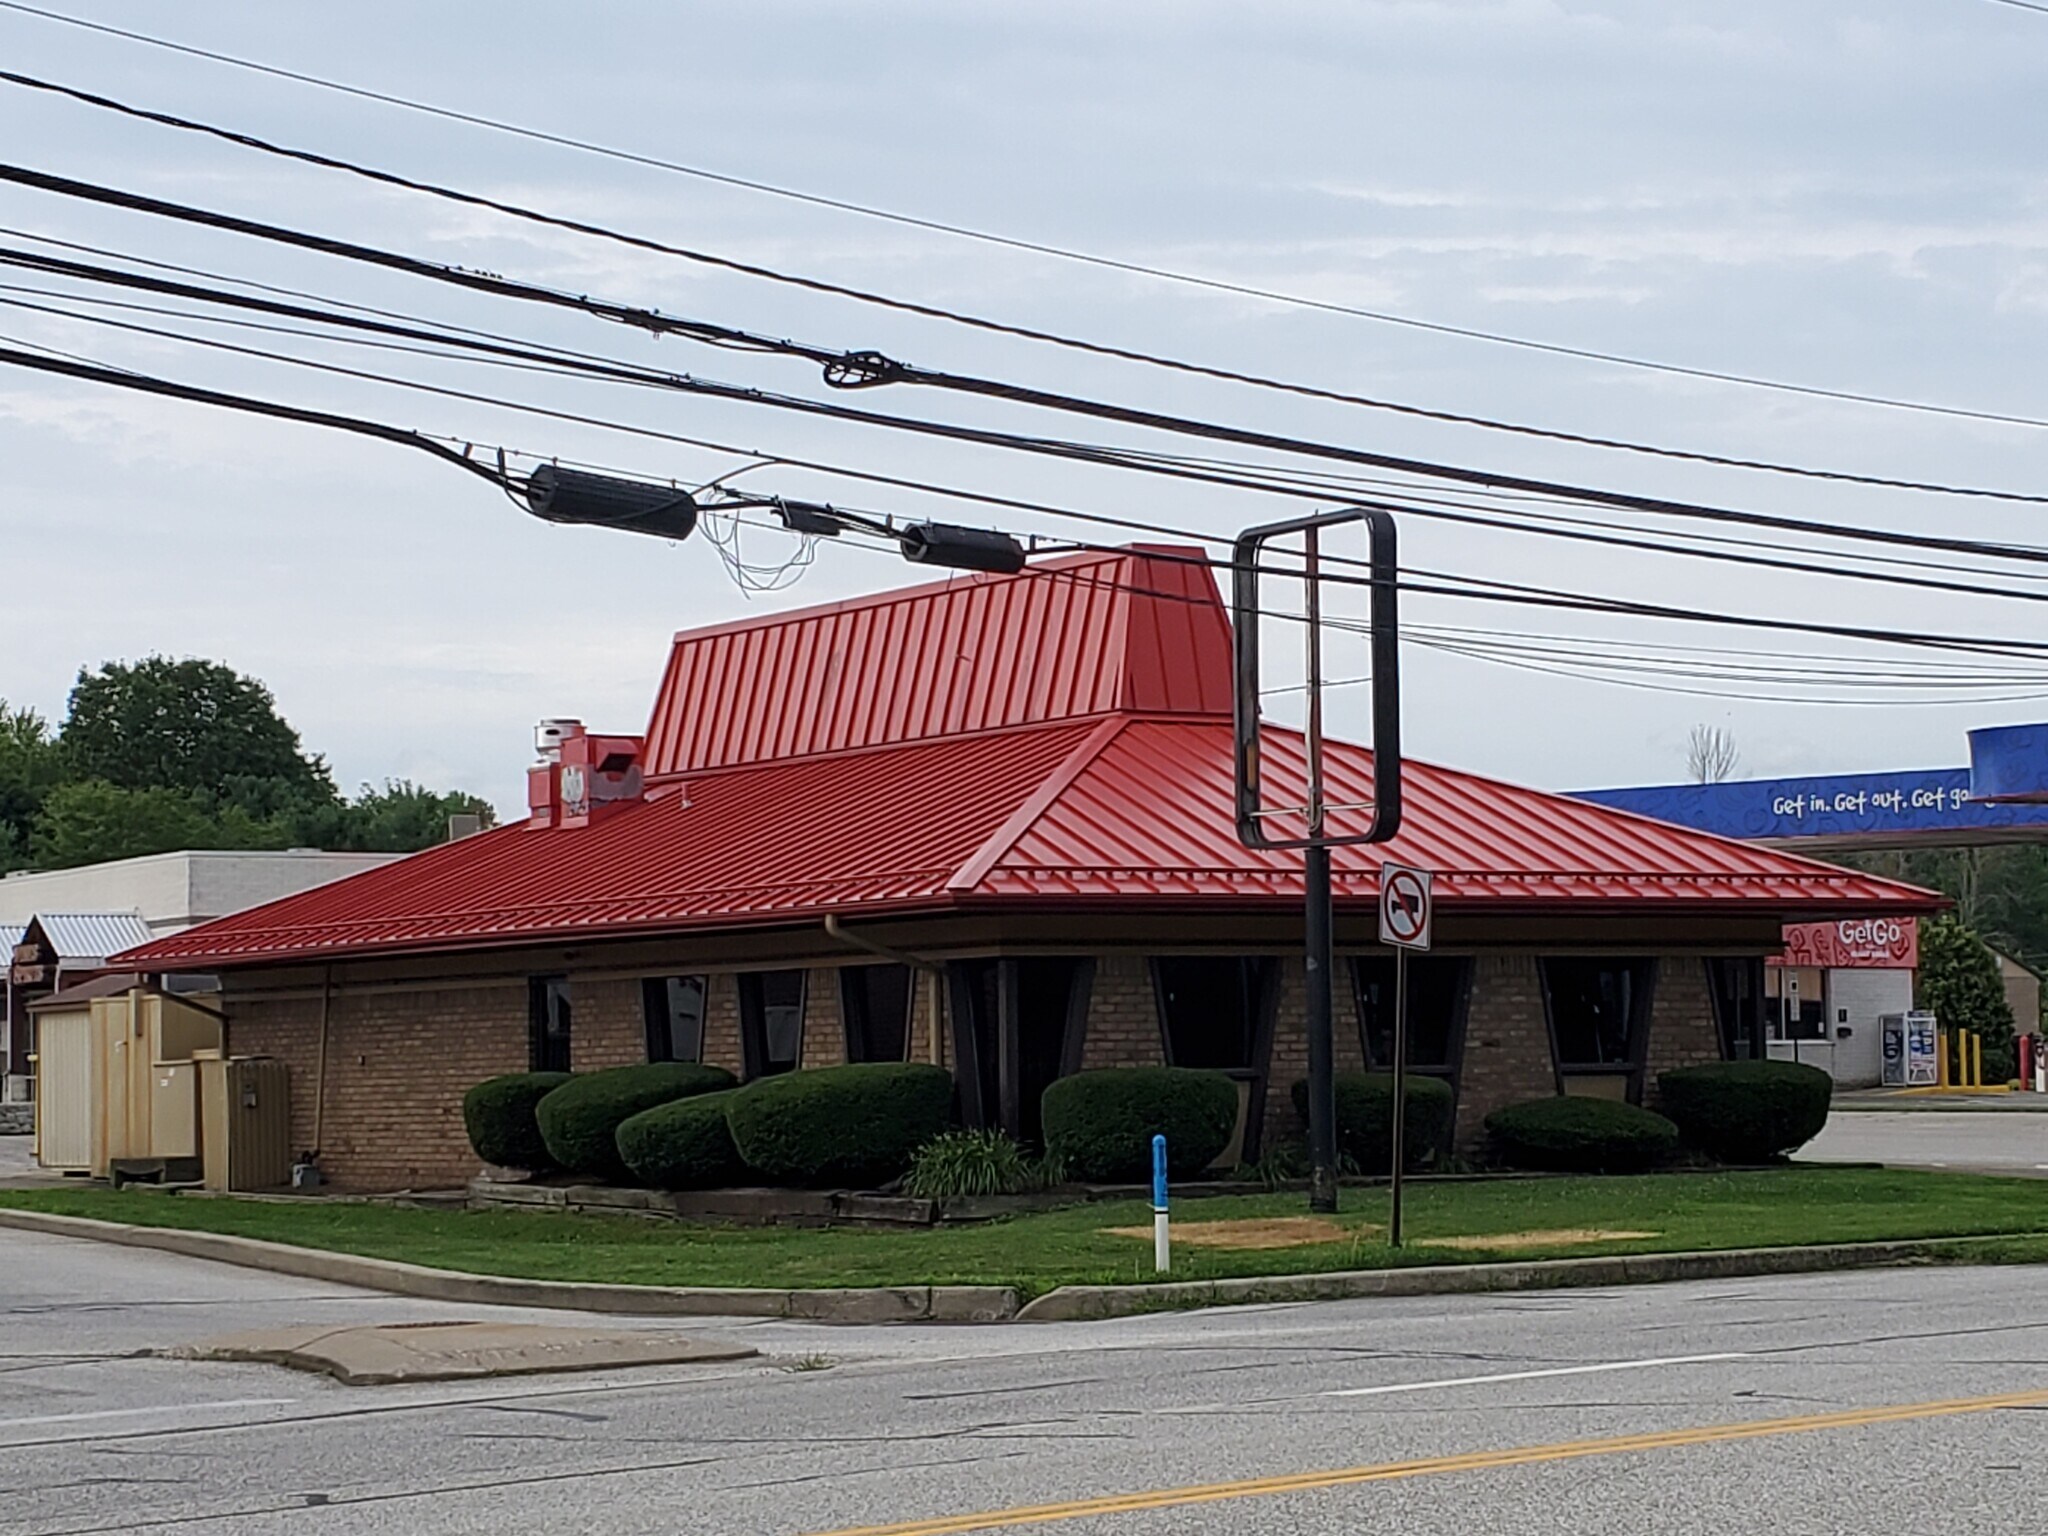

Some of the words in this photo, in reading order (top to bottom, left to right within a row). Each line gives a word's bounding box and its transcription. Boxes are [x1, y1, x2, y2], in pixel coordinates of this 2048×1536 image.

[1773, 794, 1805, 818] Get
[1810, 794, 1831, 812] in.
[1834, 791, 1867, 815] Get
[1871, 789, 1907, 813] out.
[1911, 787, 1945, 811] Get
[1840, 919, 1900, 945] GetGo
